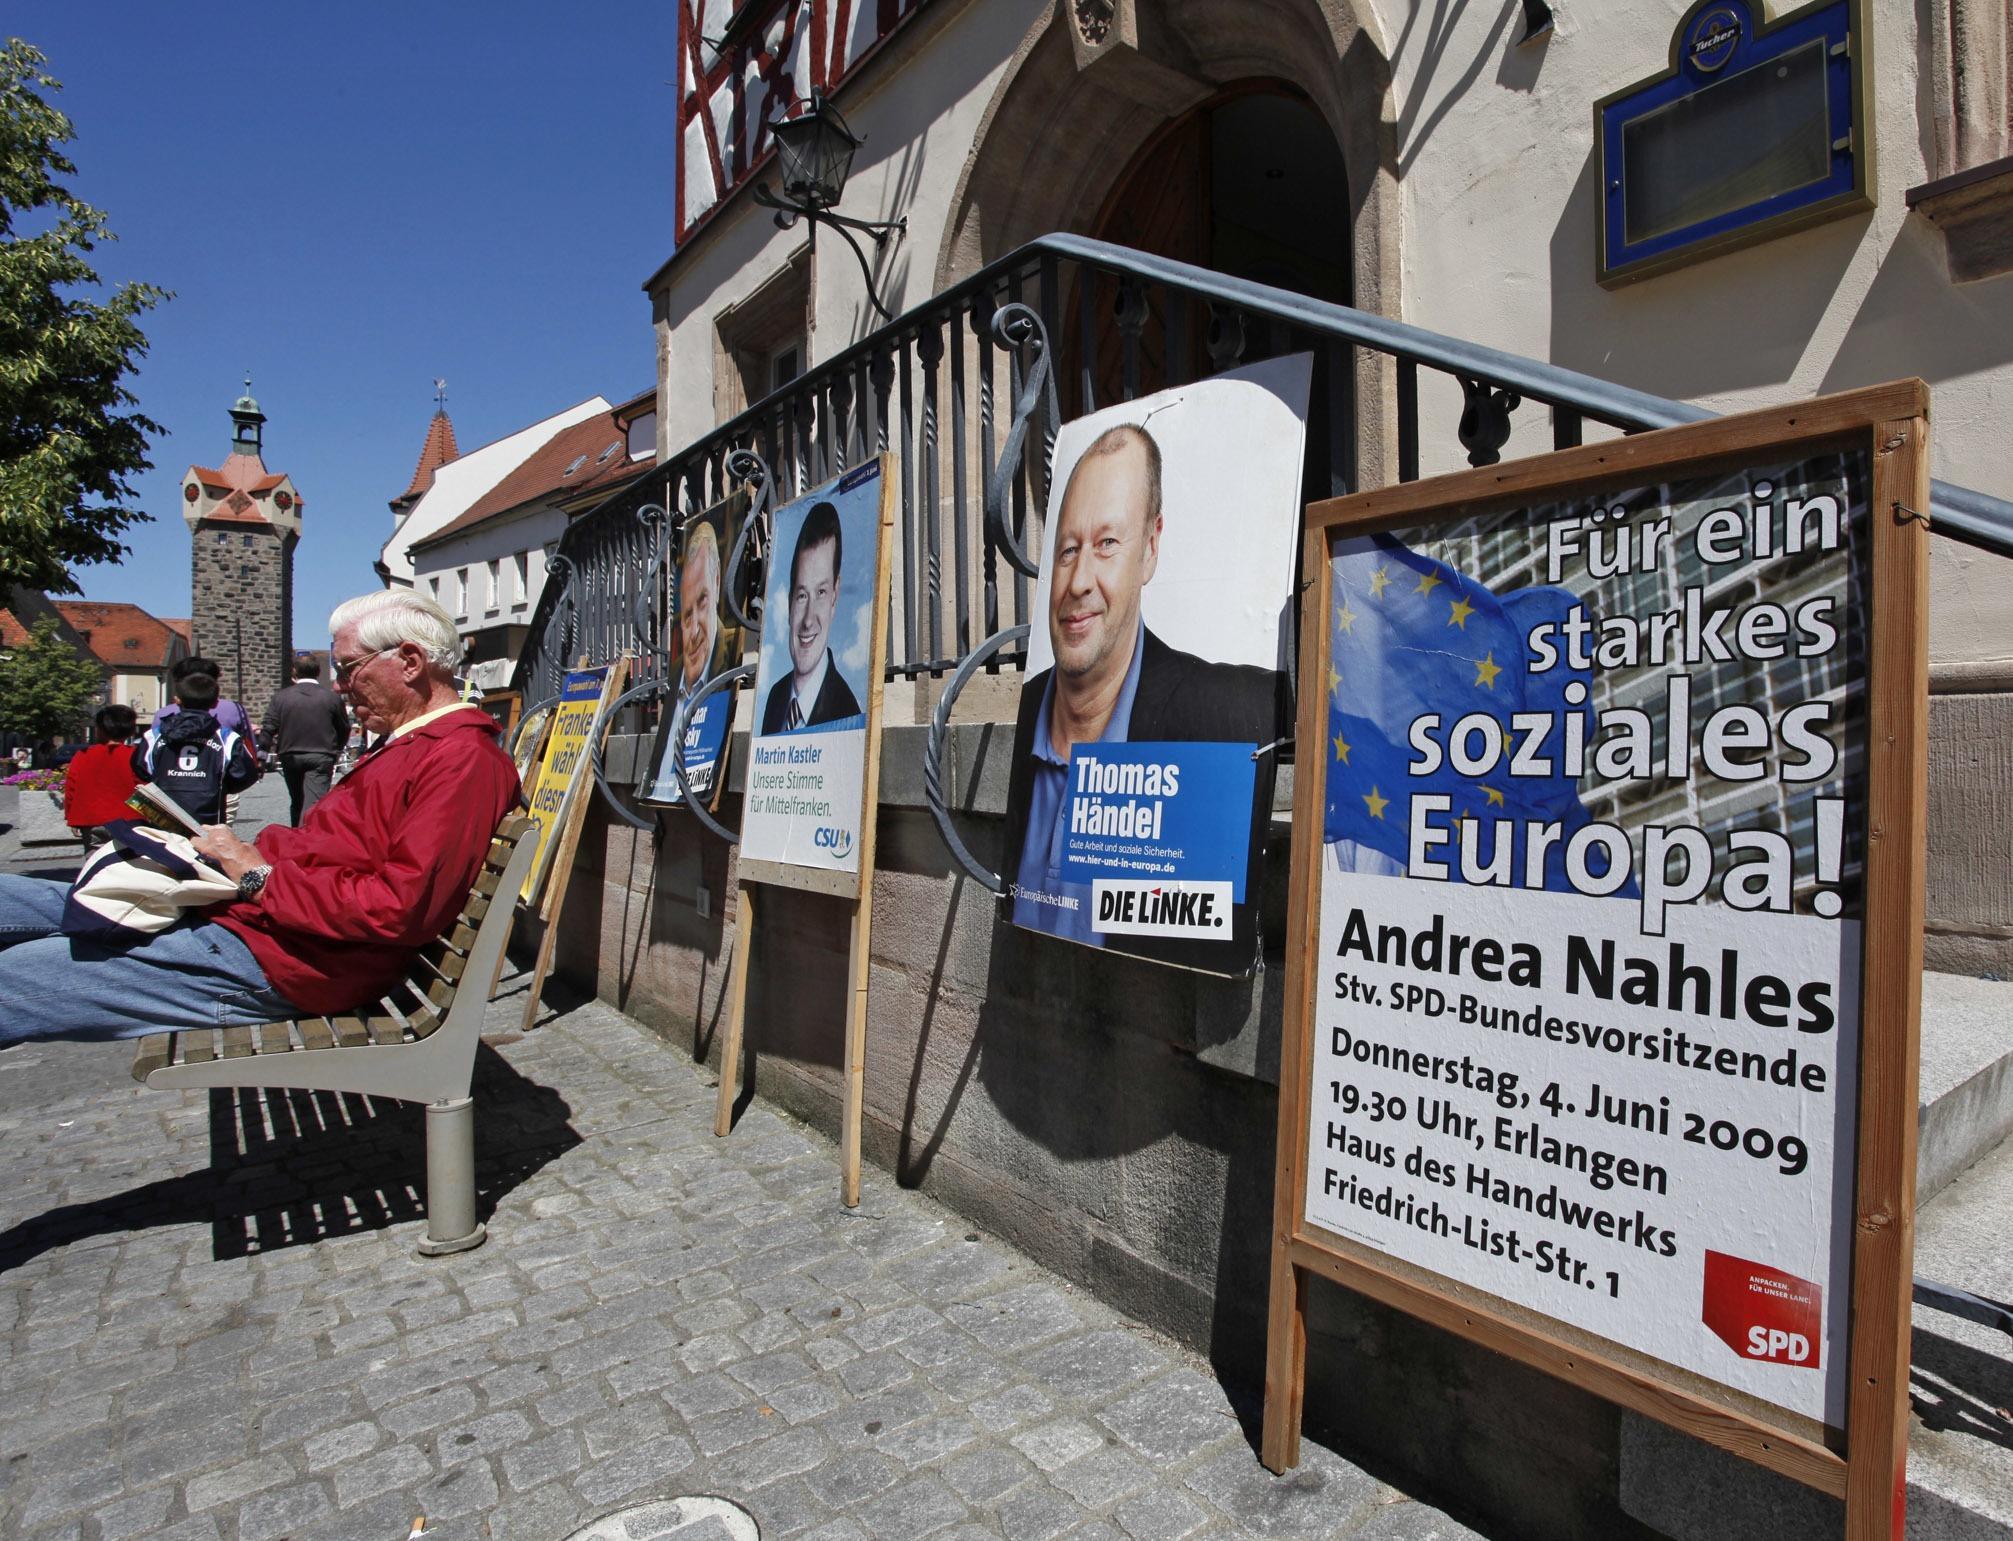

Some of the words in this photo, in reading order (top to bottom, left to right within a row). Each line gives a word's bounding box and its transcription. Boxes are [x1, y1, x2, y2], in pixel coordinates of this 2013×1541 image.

[1695, 29, 1735, 52] Tucher
[1546, 503, 1672, 584] Für
[1695, 479, 1843, 567] ein
[1528, 586, 1839, 674] starkes
[554, 704, 594, 737] Franke
[1406, 674, 1838, 783] soziales
[178, 745, 199, 771] 6
[551, 741, 584, 775] wähl
[755, 746, 785, 764] Martin
[788, 744, 822, 764] Kastler
[167, 769, 206, 777] Krannich
[753, 771, 784, 790] Unsere
[786, 771, 823, 790] Stimme
[1076, 757, 1180, 797] Thomas
[750, 795, 763, 813] für
[765, 795, 832, 817] Mittelfranken.
[1071, 797, 1162, 840] Händel
[815, 827, 840, 848] CSU
[1070, 839, 1084, 850] Gute
[1085, 841, 1103, 851] Arbeit
[1105, 842, 1117, 853] und
[1118, 844, 1142, 855] soziale
[1143, 846, 1185, 859] Sicherheit.
[1069, 855, 1175, 873] www.hier-und-in-europa.de
[1406, 792, 1846, 936] Europa!
[1099, 890, 1136, 922] DIE
[1138, 890, 1223, 928] LINKE.
[1337, 908, 1542, 988] Andrea
[1567, 935, 1835, 1034] Nahles
[1334, 973, 1382, 1007] Stv.
[1390, 983, 1827, 1093] SPD-Bundesvorsitzende
[1331, 1027, 1530, 1109] Donnerstag,
[1540, 1082, 1574, 1117] 4.
[1584, 1084, 1669, 1136] Juni
[1683, 1112, 1808, 1175] 2009
[1330, 1081, 1407, 1122] 19.30
[1418, 1097, 1483, 1151] Uhr,
[1495, 1116, 1668, 1195] Erlangen
[1326, 1122, 1395, 1168] Haus
[1405, 1144, 1455, 1187] des
[1467, 1163, 1677, 1257] Handwerks
[1324, 1168, 1594, 1290] Friedrich-List-Str.
[1605, 1271, 1619, 1298] 1
[1749, 1276, 1790, 1290] ANPACKEN.
[1749, 1284, 1763, 1293] FÜR
[1764, 1288, 1788, 1299] UNSER
[1747, 1326, 1810, 1361] SPD
